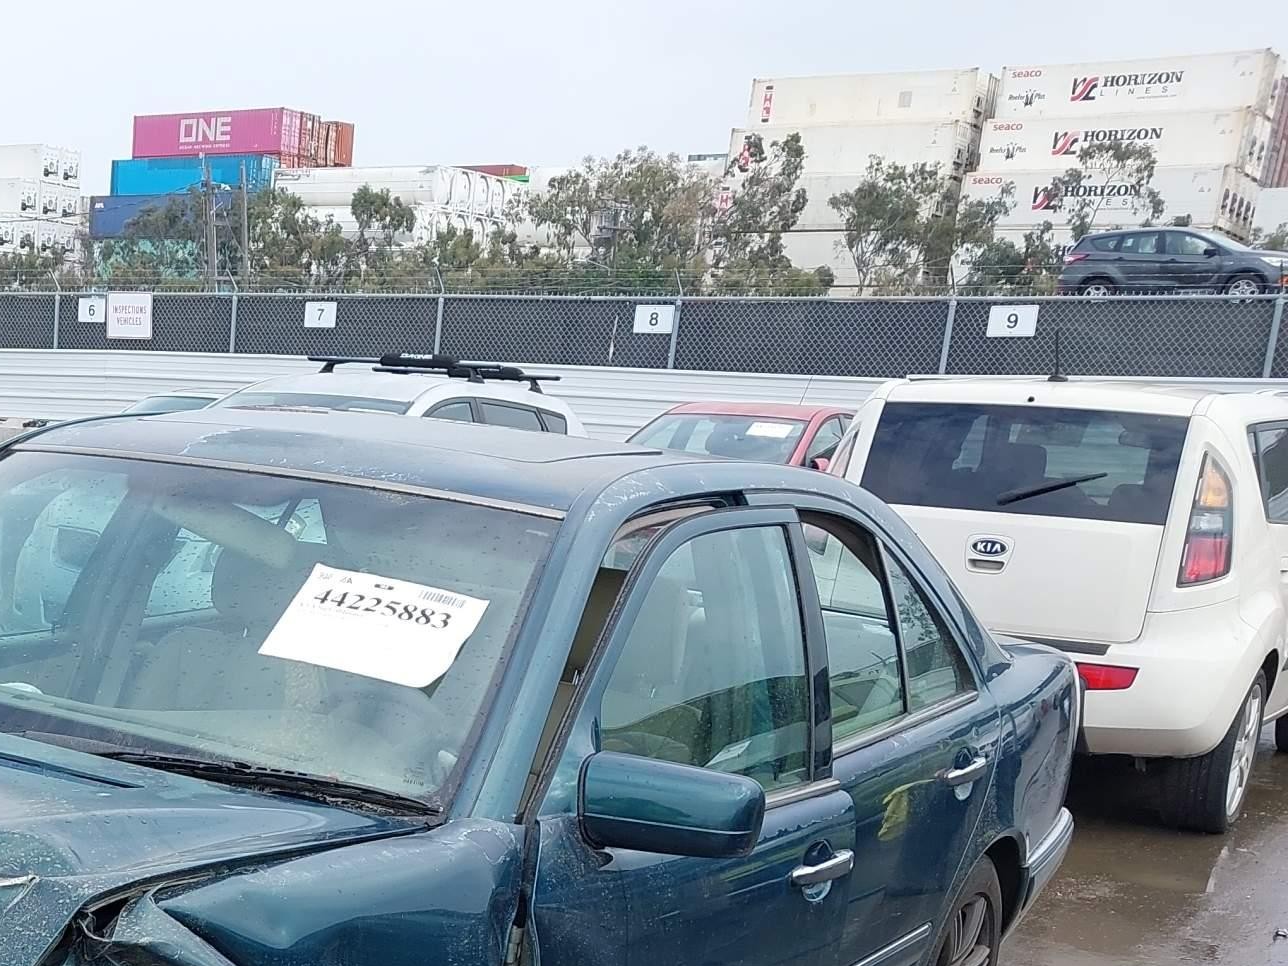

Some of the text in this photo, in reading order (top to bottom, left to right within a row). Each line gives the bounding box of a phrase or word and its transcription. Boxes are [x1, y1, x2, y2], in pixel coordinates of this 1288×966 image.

[1012, 70, 1042, 78] seaco
[1101, 70, 1185, 88] HORIZON
[1099, 86, 1169, 96] LINES
[179, 116, 232, 142] ONE
[993, 123, 1023, 131] seaco
[1082, 127, 1164, 143] HORIZON
[971, 175, 1003, 185] seaco
[1063, 184, 1142, 198] HORIZON
[88, 304, 96, 317] 6
[112, 305, 147, 314] INSPECTIONS
[317, 308, 325, 321] 7
[116, 316, 142, 326] VEHICLES
[649, 312, 659, 327] 8
[1006, 313, 1019, 329] 9
[976, 541, 1002, 553] KIA
[314, 589, 452, 628] 44225883
